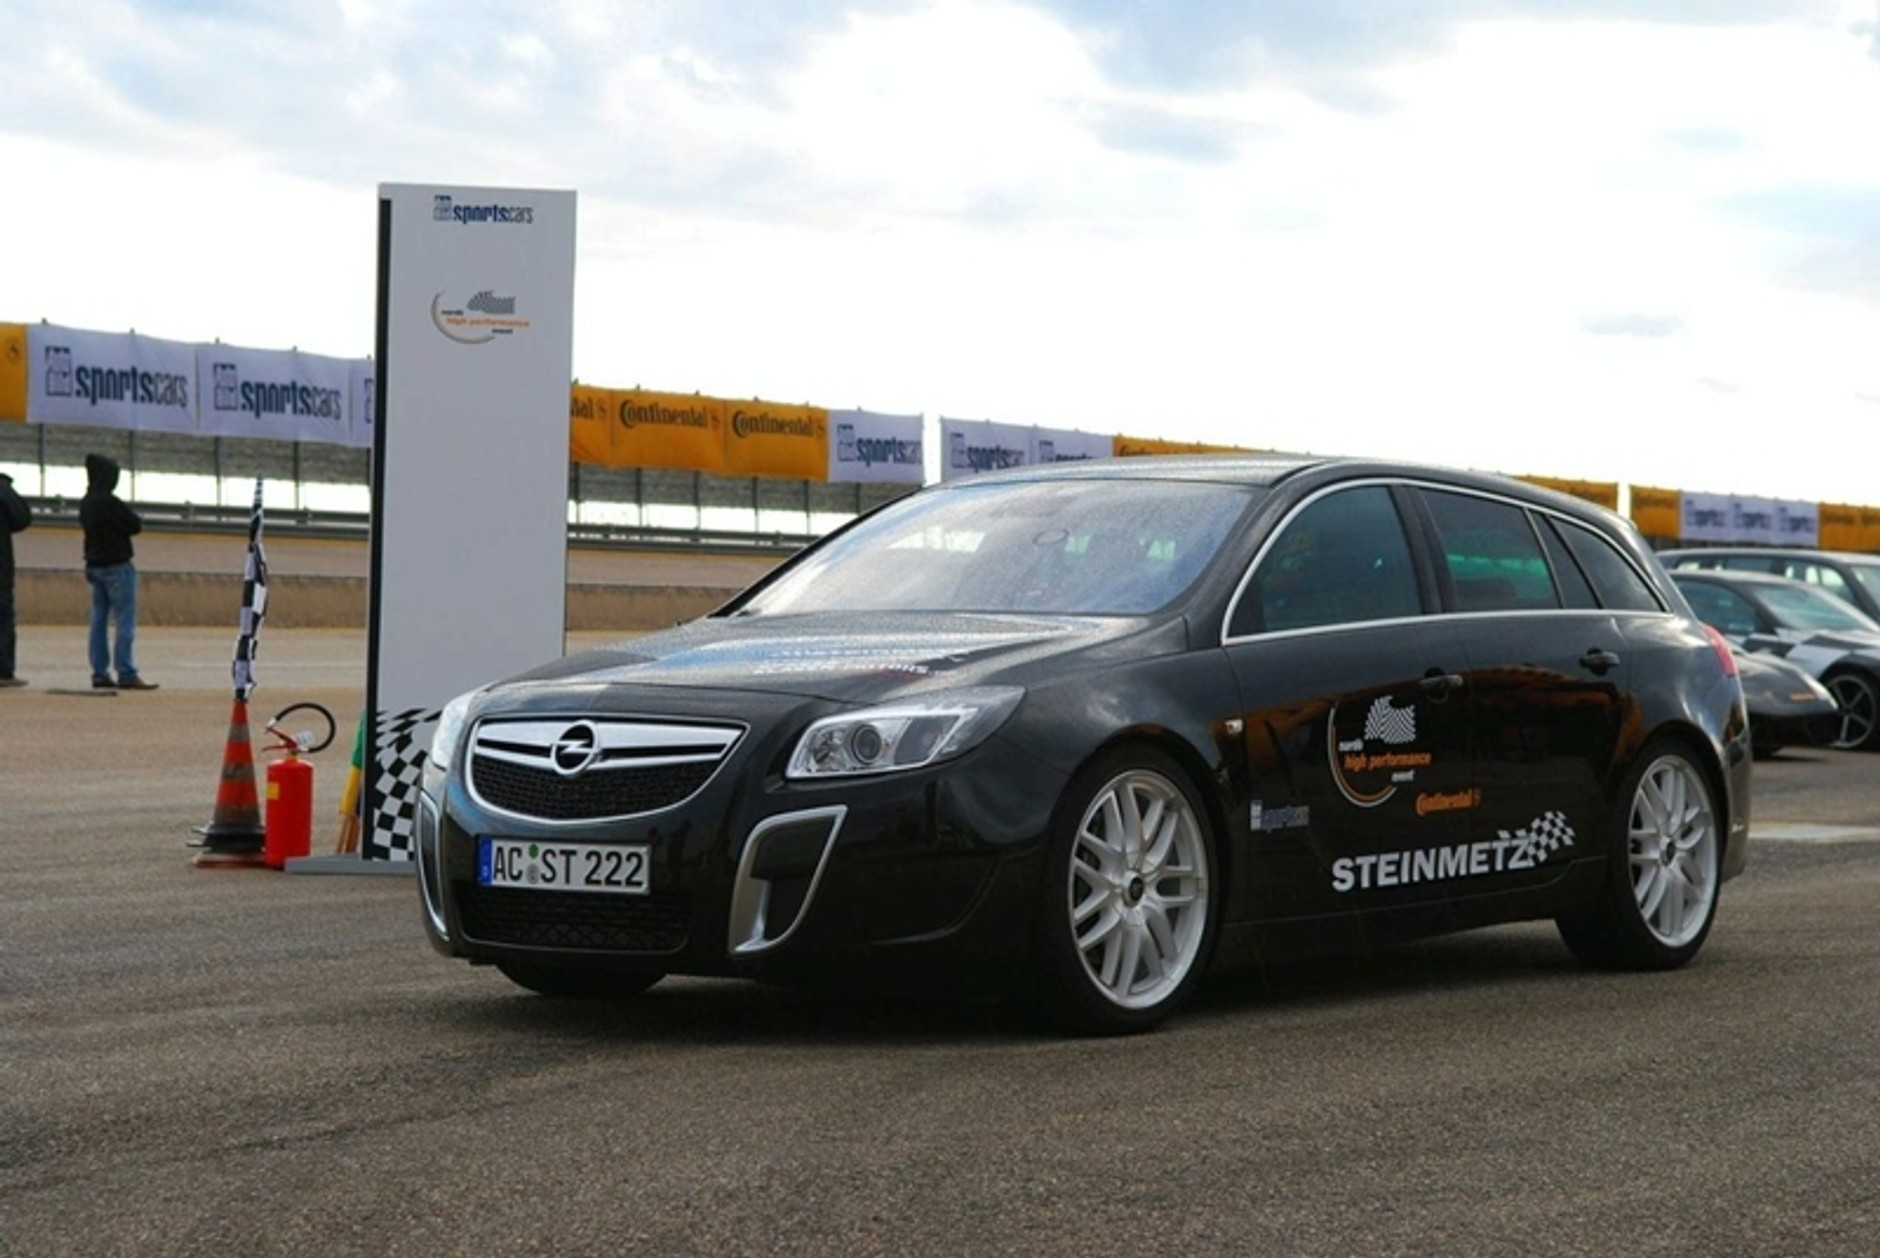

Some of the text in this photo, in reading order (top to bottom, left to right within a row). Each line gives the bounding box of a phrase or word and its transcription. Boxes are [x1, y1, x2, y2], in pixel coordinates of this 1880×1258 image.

[453, 204, 533, 224] sportscars
[75, 365, 188, 407] sportscars
[240, 380, 342, 420] sportscars
[620, 400, 708, 429] Continental
[732, 410, 814, 438] Continental
[1344, 753, 1431, 771] high performance
[493, 846, 643, 887] AC ST 222
[1332, 840, 1535, 892] STEINMETZ
